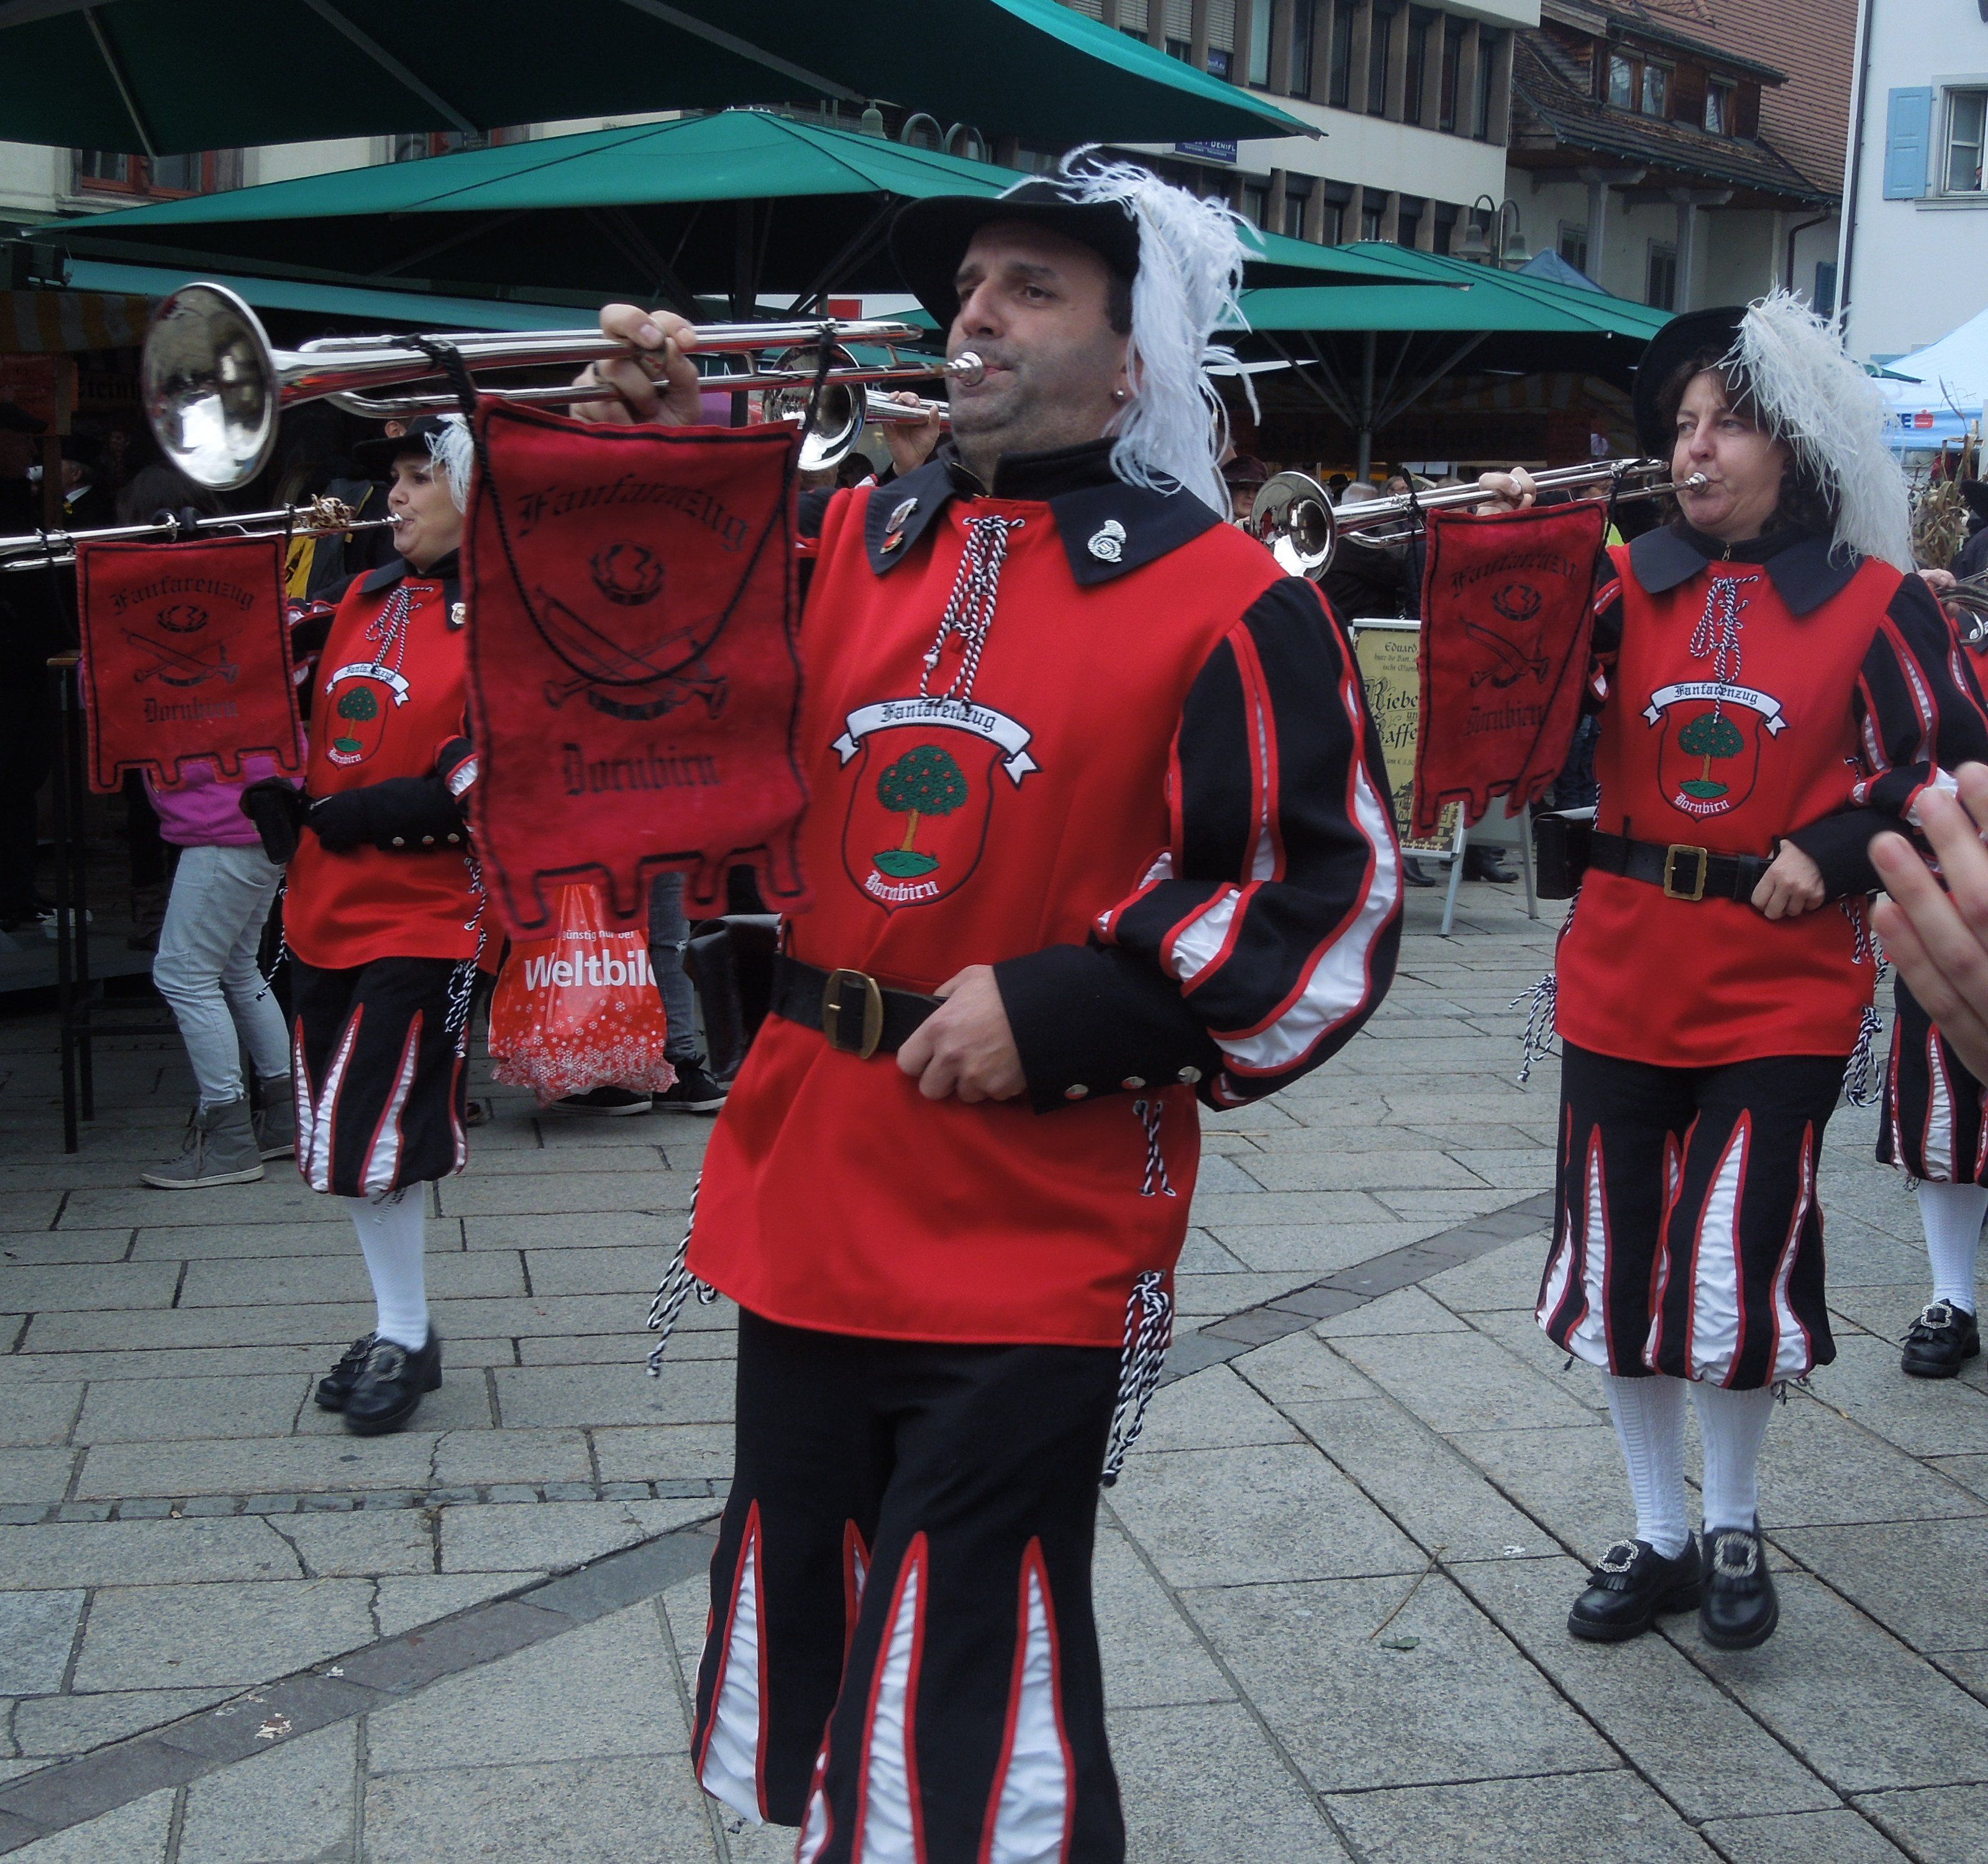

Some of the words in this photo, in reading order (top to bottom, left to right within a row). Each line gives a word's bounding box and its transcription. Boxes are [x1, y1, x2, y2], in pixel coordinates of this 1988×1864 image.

[110, 575, 255, 615] Fanfarenzug
[1364, 677, 1418, 710] Riebe
[1674, 683, 1758, 705] Fanfarenzug
[144, 697, 238, 723] Dornbirn
[880, 700, 996, 733] Fanfarenzug
[563, 742, 720, 796] Dornbirn
[1674, 792, 1730, 813] Dornbirn
[865, 870, 939, 901] Dornbirn
